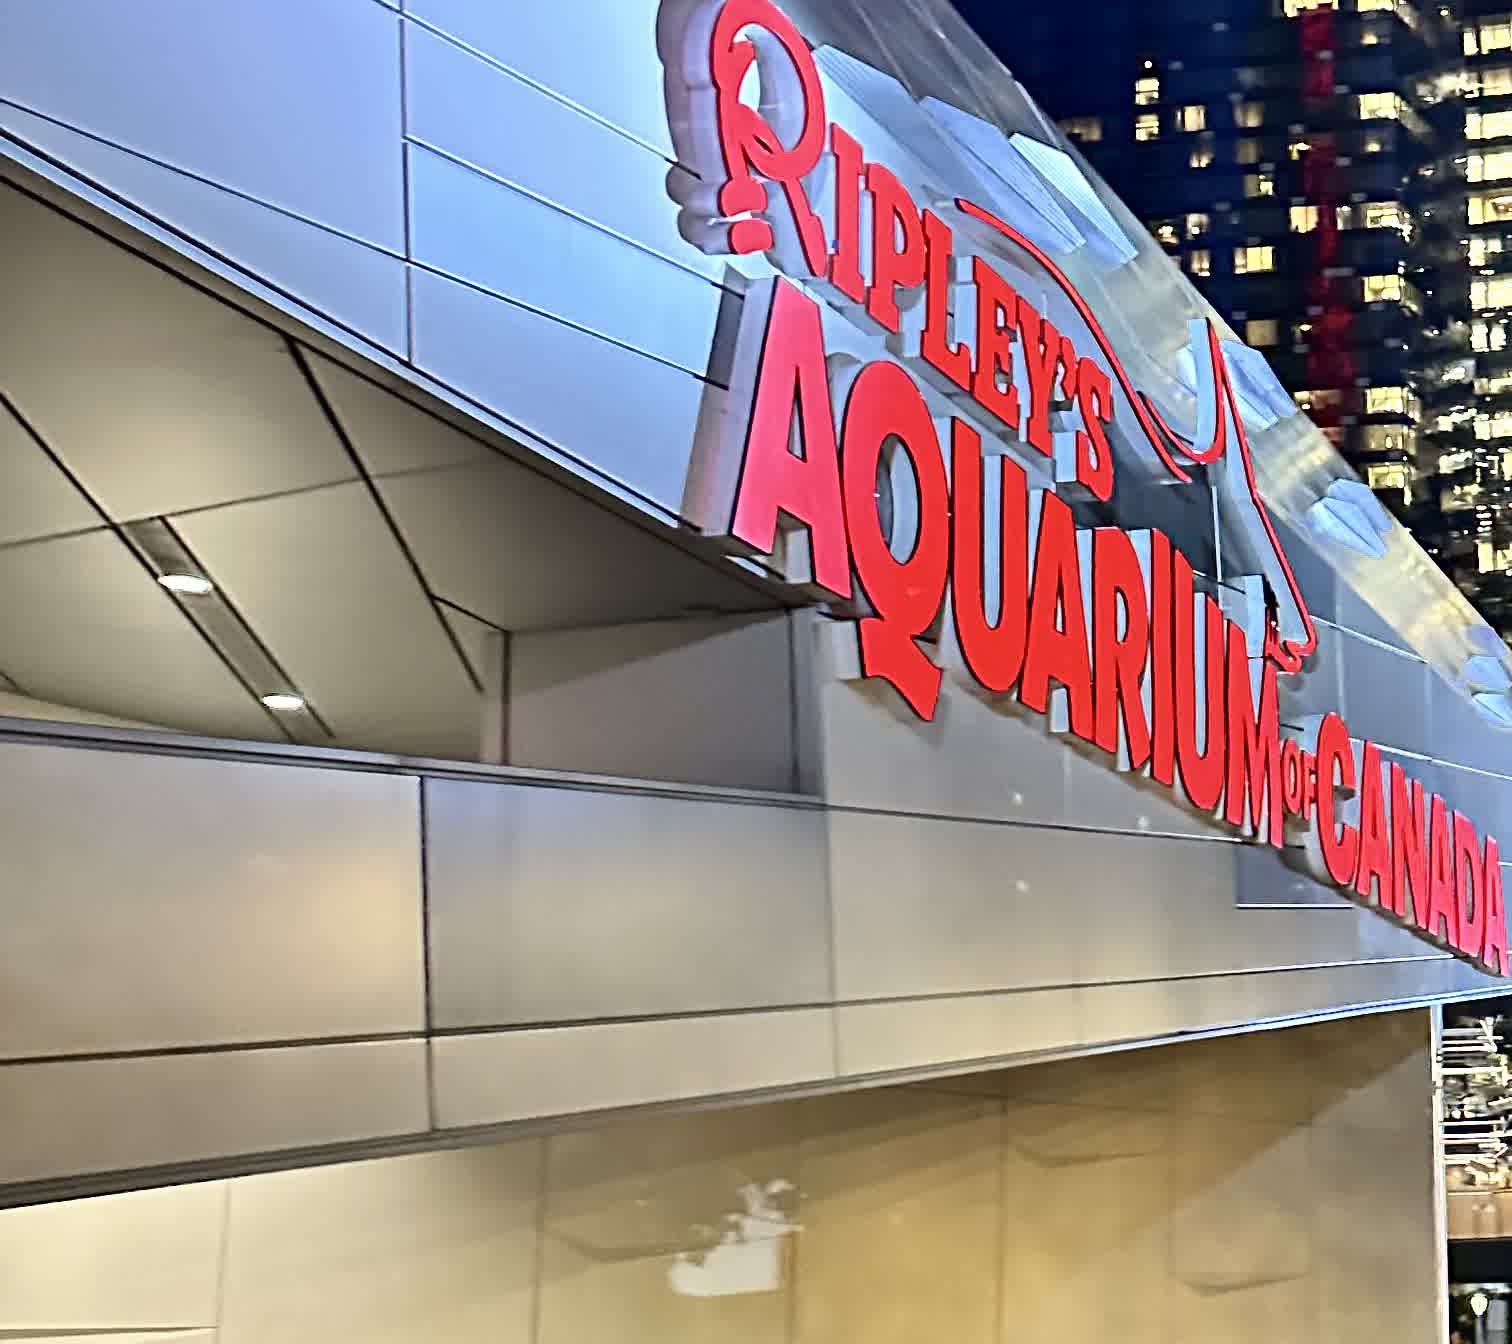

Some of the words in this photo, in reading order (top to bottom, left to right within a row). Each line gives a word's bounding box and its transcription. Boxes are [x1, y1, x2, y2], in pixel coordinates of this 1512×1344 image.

[732, 276, 1285, 848] AQUARIUM
[1281, 738, 1317, 822] OF
[1316, 711, 1511, 977] CANADA
